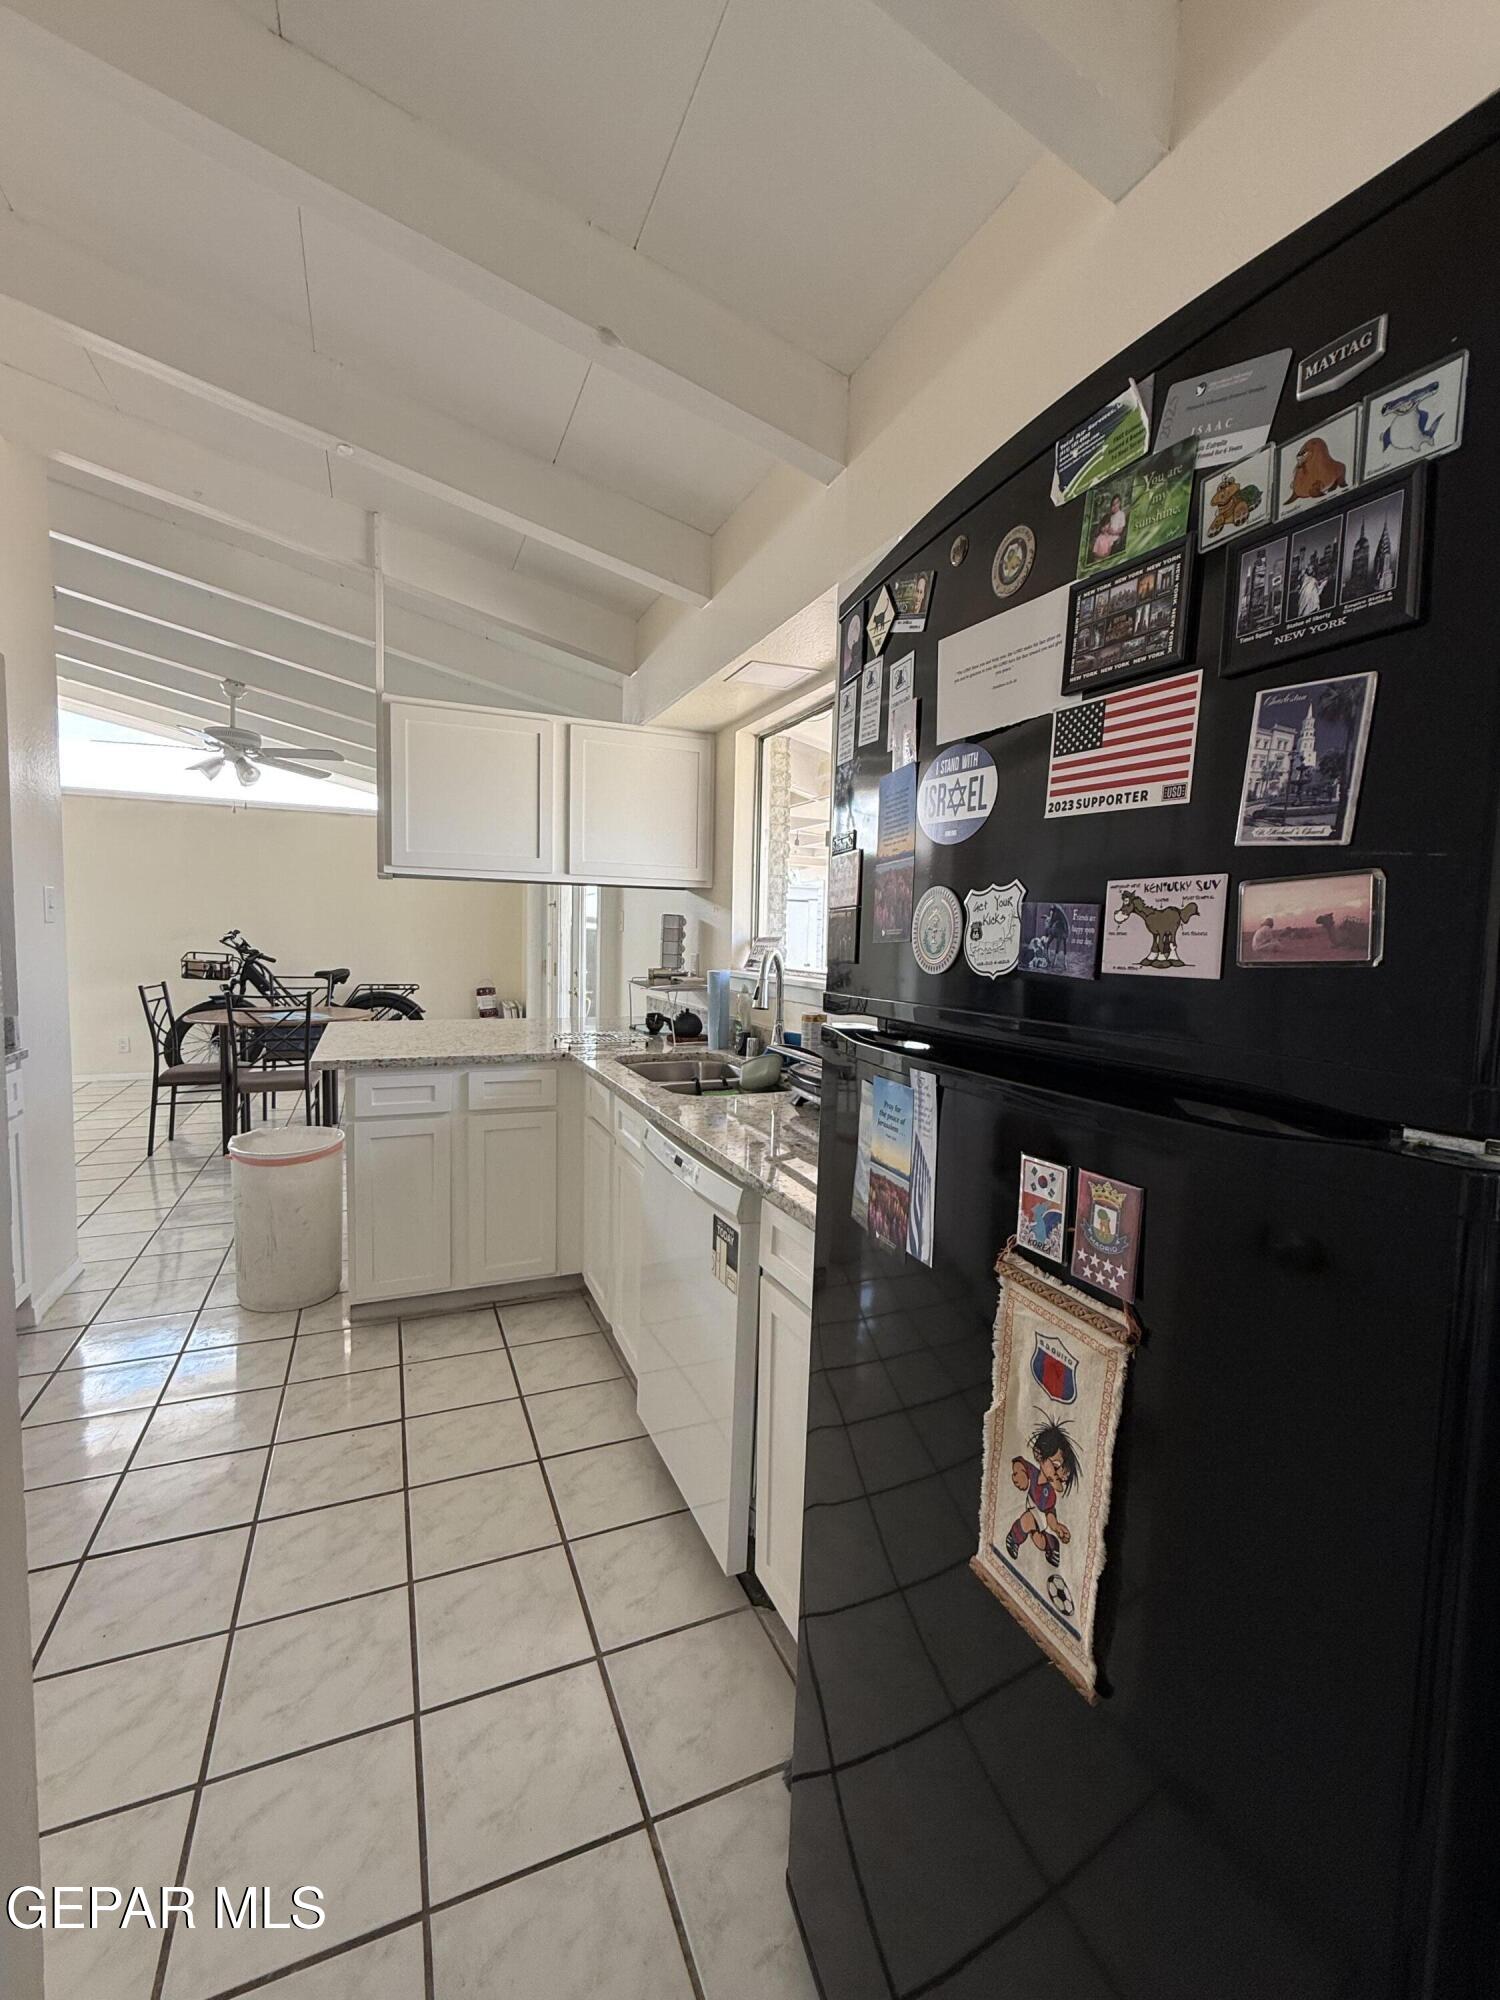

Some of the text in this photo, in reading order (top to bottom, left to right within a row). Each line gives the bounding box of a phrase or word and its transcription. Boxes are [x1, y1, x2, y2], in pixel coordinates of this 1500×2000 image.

[1304, 331, 1373, 380] MAYTAG
[1143, 464, 1183, 492] You are
[1152, 490, 1167, 505] my
[1146, 562, 1162, 572] NEW
[1273, 616, 1348, 645] NEW YORK
[1100, 665, 1113, 674] NEW
[1114, 661, 1130, 670] YORK
[1132, 655, 1147, 664] NEW
[1148, 650, 1165, 660] YORK
[935, 751, 979, 775] I STAND WITH
[1047, 789, 1149, 813] 2023 SUPPORTER
[1166, 784, 1182, 799] USO
[1143, 879, 1192, 893] KENTUCKY
[1195, 879, 1222, 891] SUV
[716, 1225, 736, 1247] TODAY
